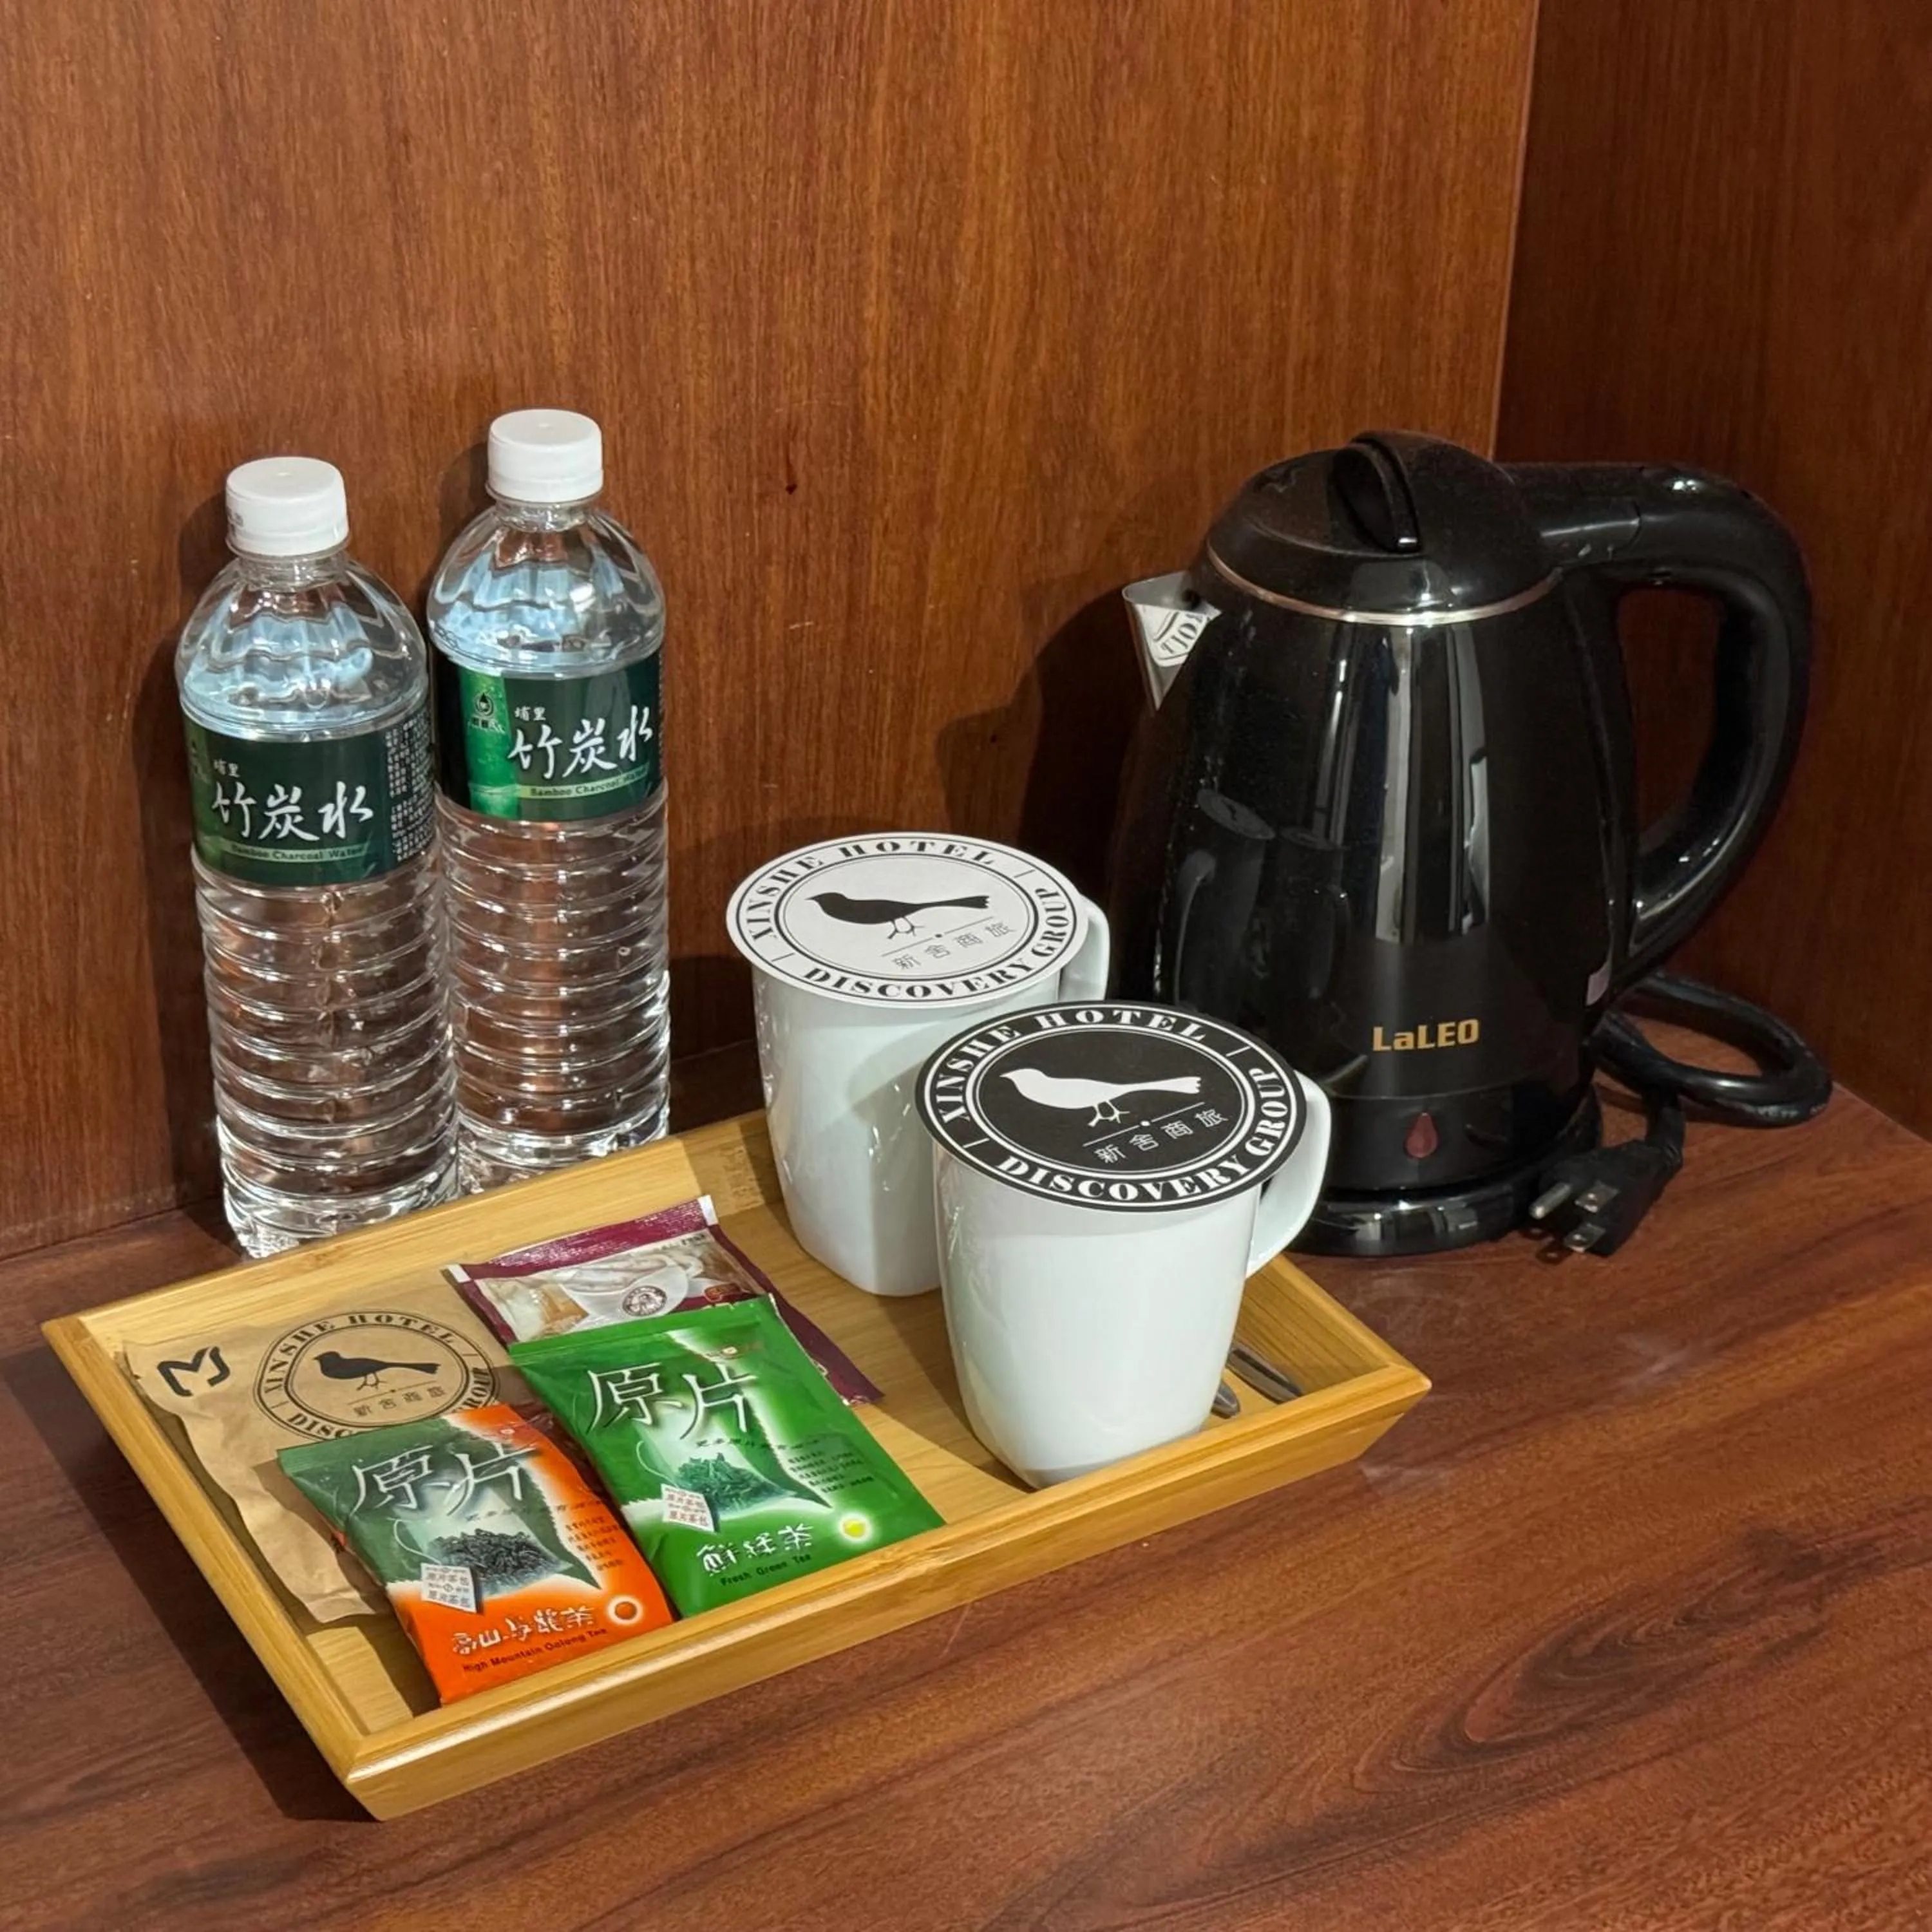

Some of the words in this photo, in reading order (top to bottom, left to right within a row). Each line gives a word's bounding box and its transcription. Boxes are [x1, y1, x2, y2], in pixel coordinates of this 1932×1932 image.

[507, 705, 653, 779] 竹炭水
[212, 781, 374, 841] 竹炭水
[272, 850, 323, 860] Charcoal
[747, 855, 824, 940] XINSHE
[838, 839, 996, 865] HOTEL
[804, 958, 1032, 998] DISCOVERY
[1031, 887, 1070, 957] GROUP
[935, 1026, 1020, 1122] XINSHE
[1036, 1009, 1206, 1041] HOTEL
[1372, 1018, 1479, 1052] LaLEO
[995, 1155, 1251, 1200] DISCOVERY
[1245, 1068, 1288, 1157] GROUP
[1094, 1107, 1228, 1164] 新舍商旅
[263, 1321, 336, 1394] XINSHE
[348, 1314, 454, 1344] HOTEL
[586, 1361, 758, 1440] 原片
[350, 1441, 536, 1517] 原片
[792, 1554, 811, 1564] Tea
[491, 1646, 543, 1667] Mountain
